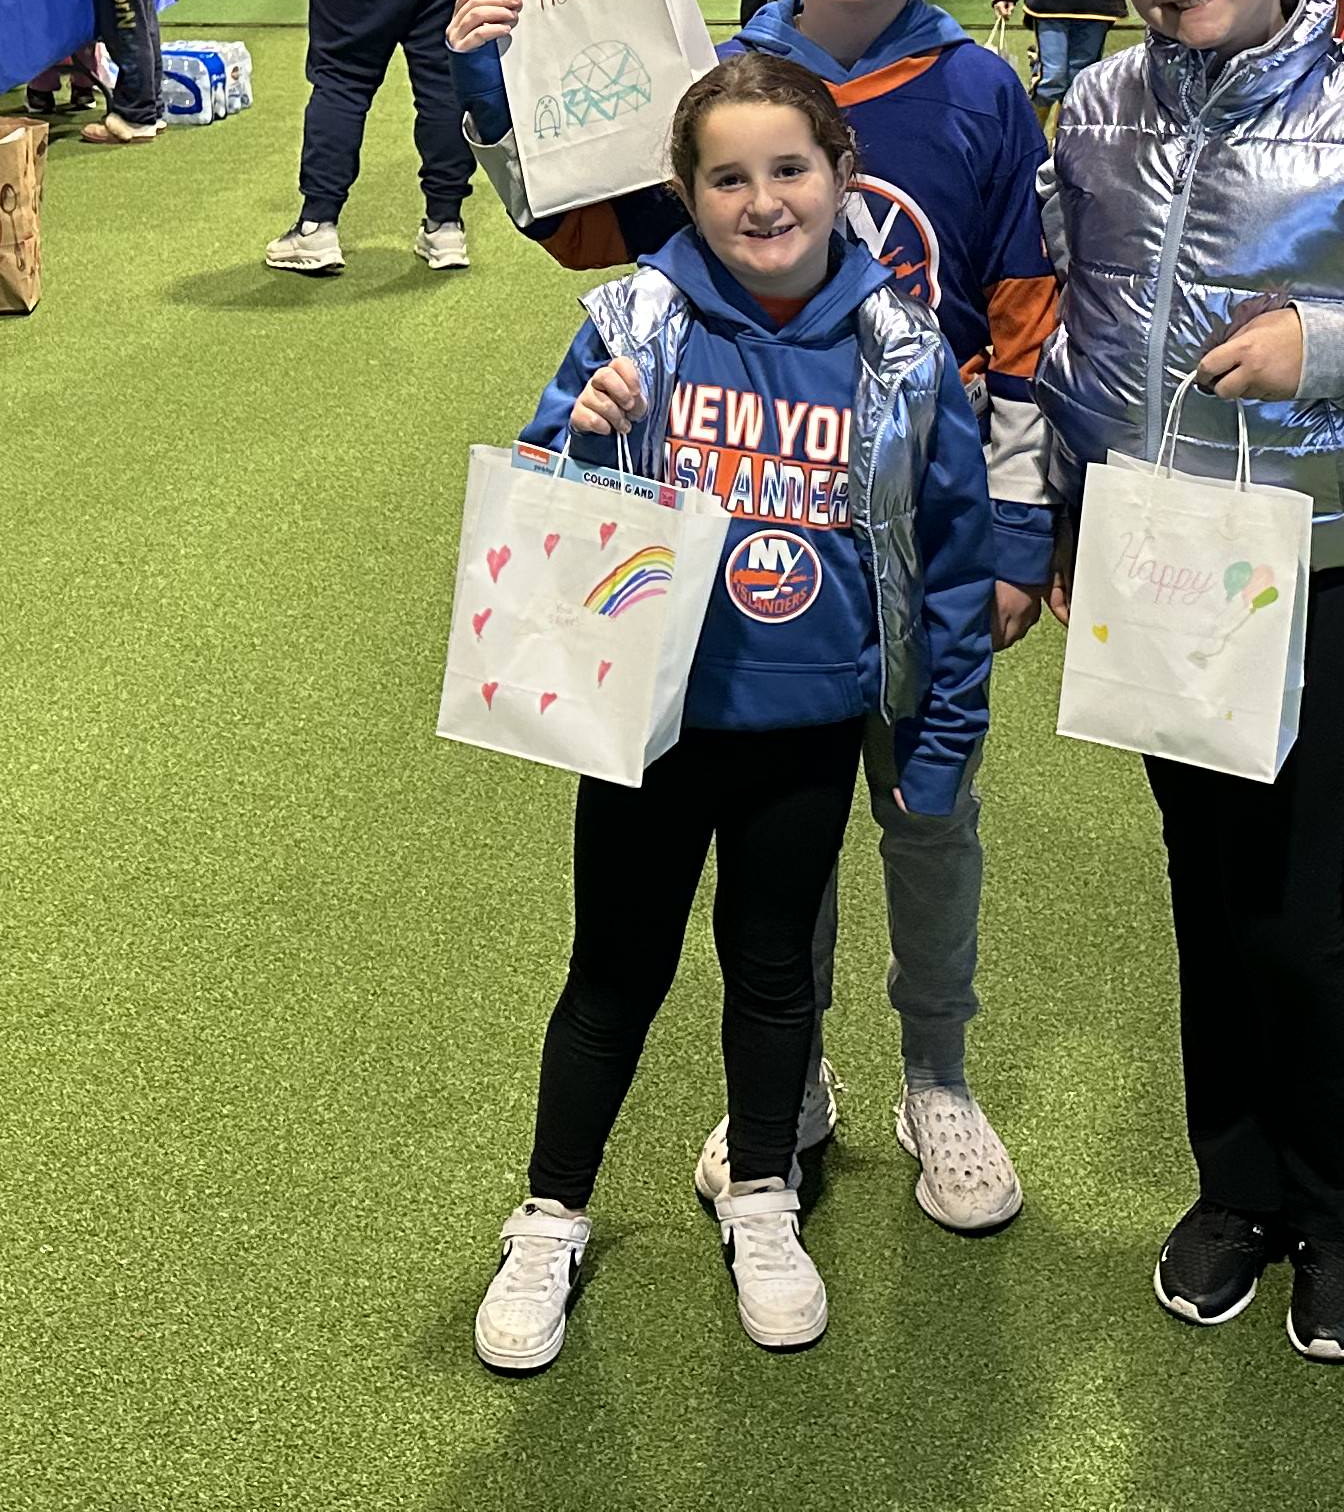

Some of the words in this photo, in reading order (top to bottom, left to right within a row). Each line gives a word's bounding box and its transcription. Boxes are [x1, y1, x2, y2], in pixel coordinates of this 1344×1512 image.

[669, 381, 765, 450] NEW
[774, 399, 852, 464] YO
[634, 486, 654, 500] AND
[747, 538, 805, 588] NY
[1113, 531, 1218, 606] Happy
[733, 582, 809, 614] ISLANDERS
